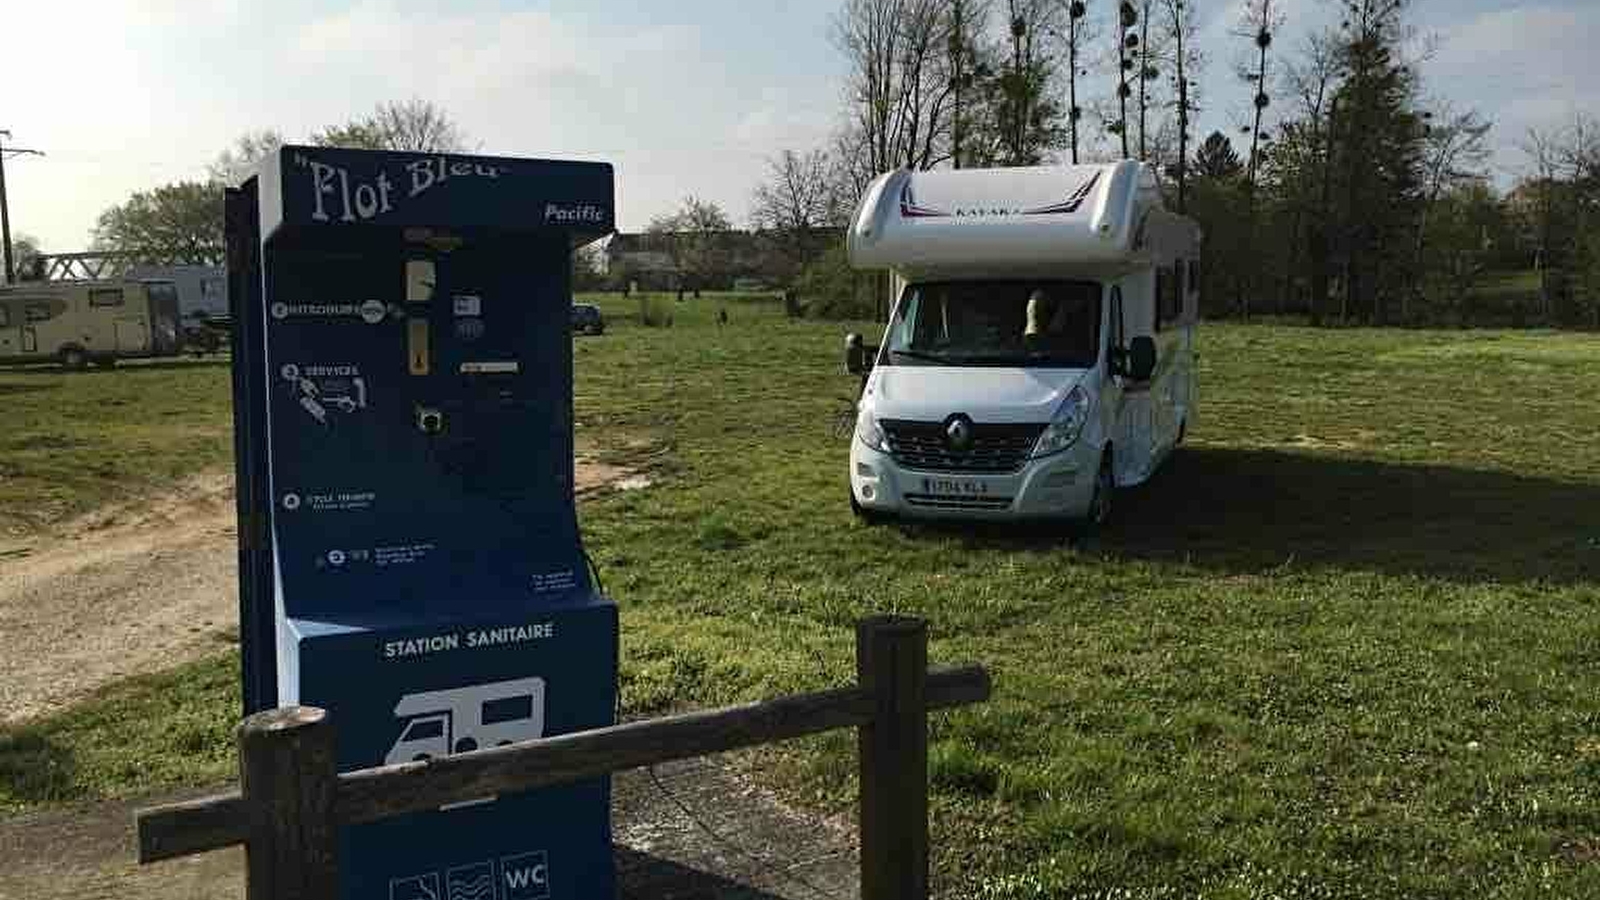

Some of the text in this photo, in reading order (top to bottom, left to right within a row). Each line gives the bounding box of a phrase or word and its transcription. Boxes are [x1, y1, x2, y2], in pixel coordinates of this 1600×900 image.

[543, 202, 603, 222] Pacific
[385, 623, 554, 658] STATION SANITAIRE
[506, 864, 546, 889] WC
